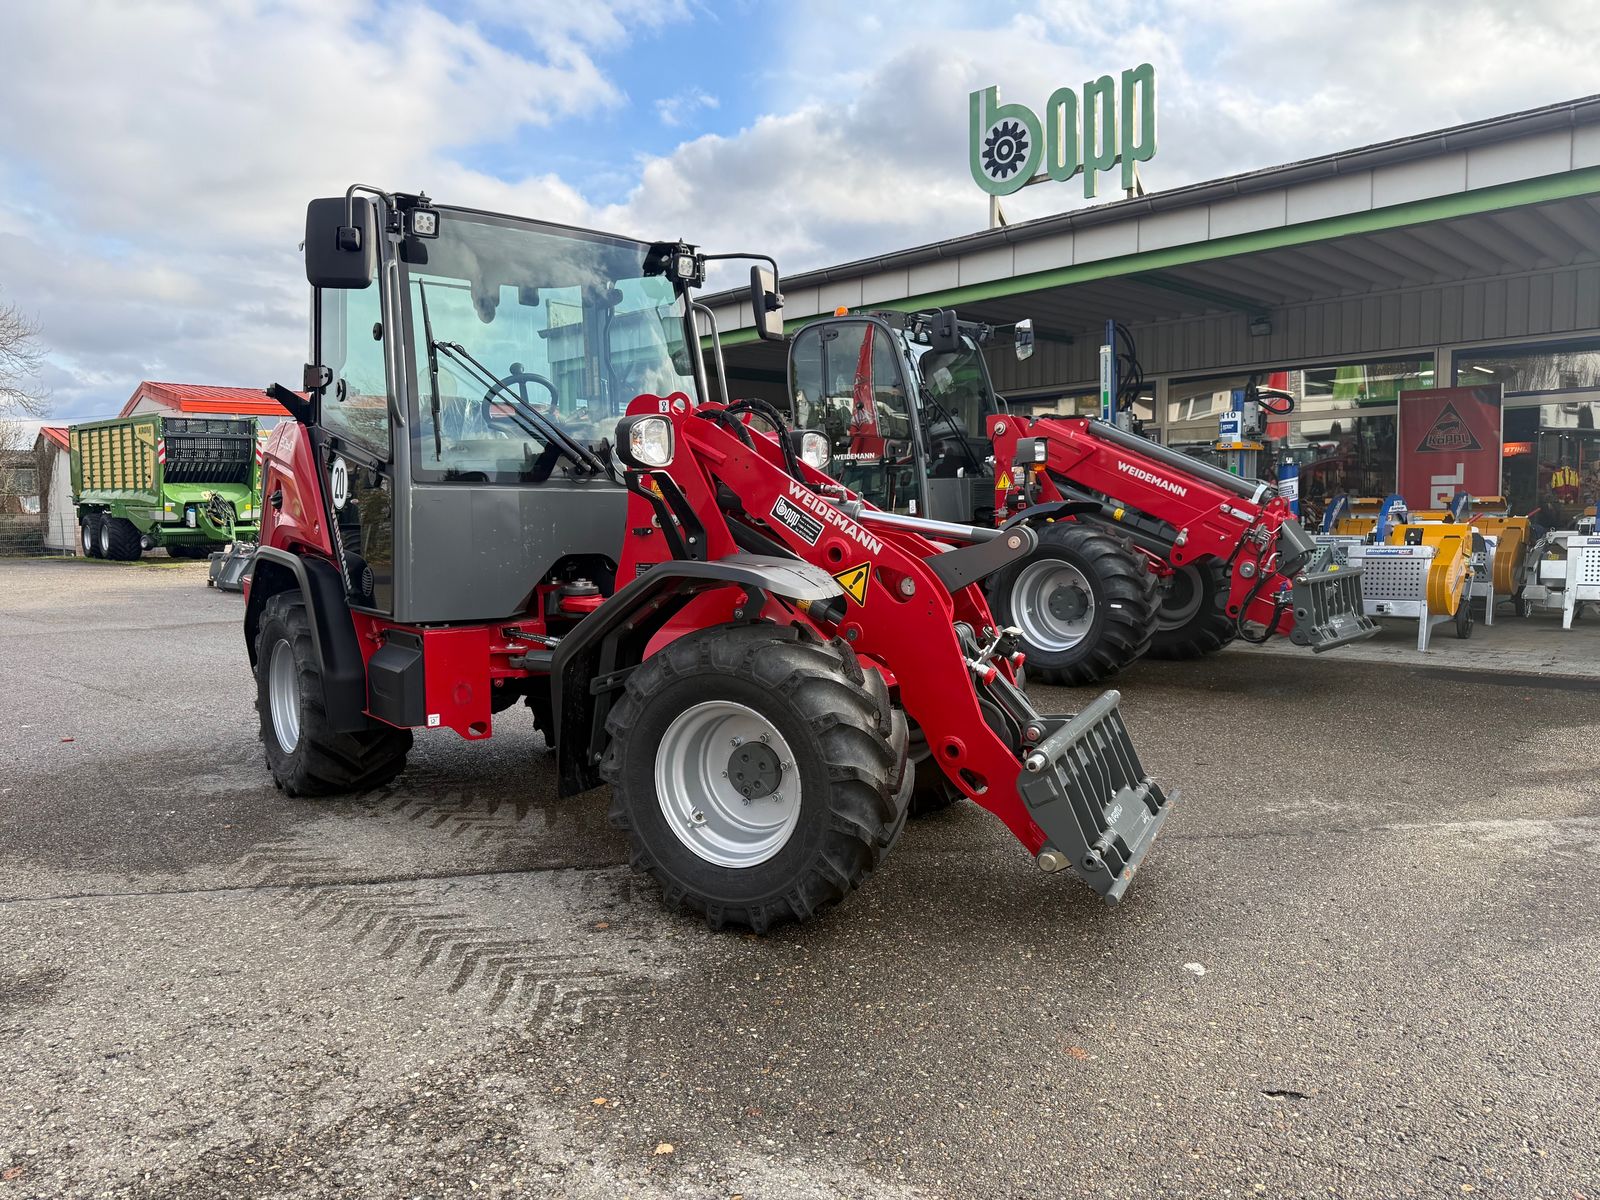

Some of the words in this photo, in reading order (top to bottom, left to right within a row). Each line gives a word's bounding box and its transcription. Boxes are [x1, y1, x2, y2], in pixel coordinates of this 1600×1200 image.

[969, 62, 1157, 199] bopp
[833, 452, 875, 461] WEIDEMANN
[334, 467, 344, 500] 20
[1117, 460, 1188, 497] WEIDEMANN
[776, 498, 801, 528] bopp
[788, 481, 884, 556] WEIDEMANN
[331, 502, 352, 591] WEIDEMANN
